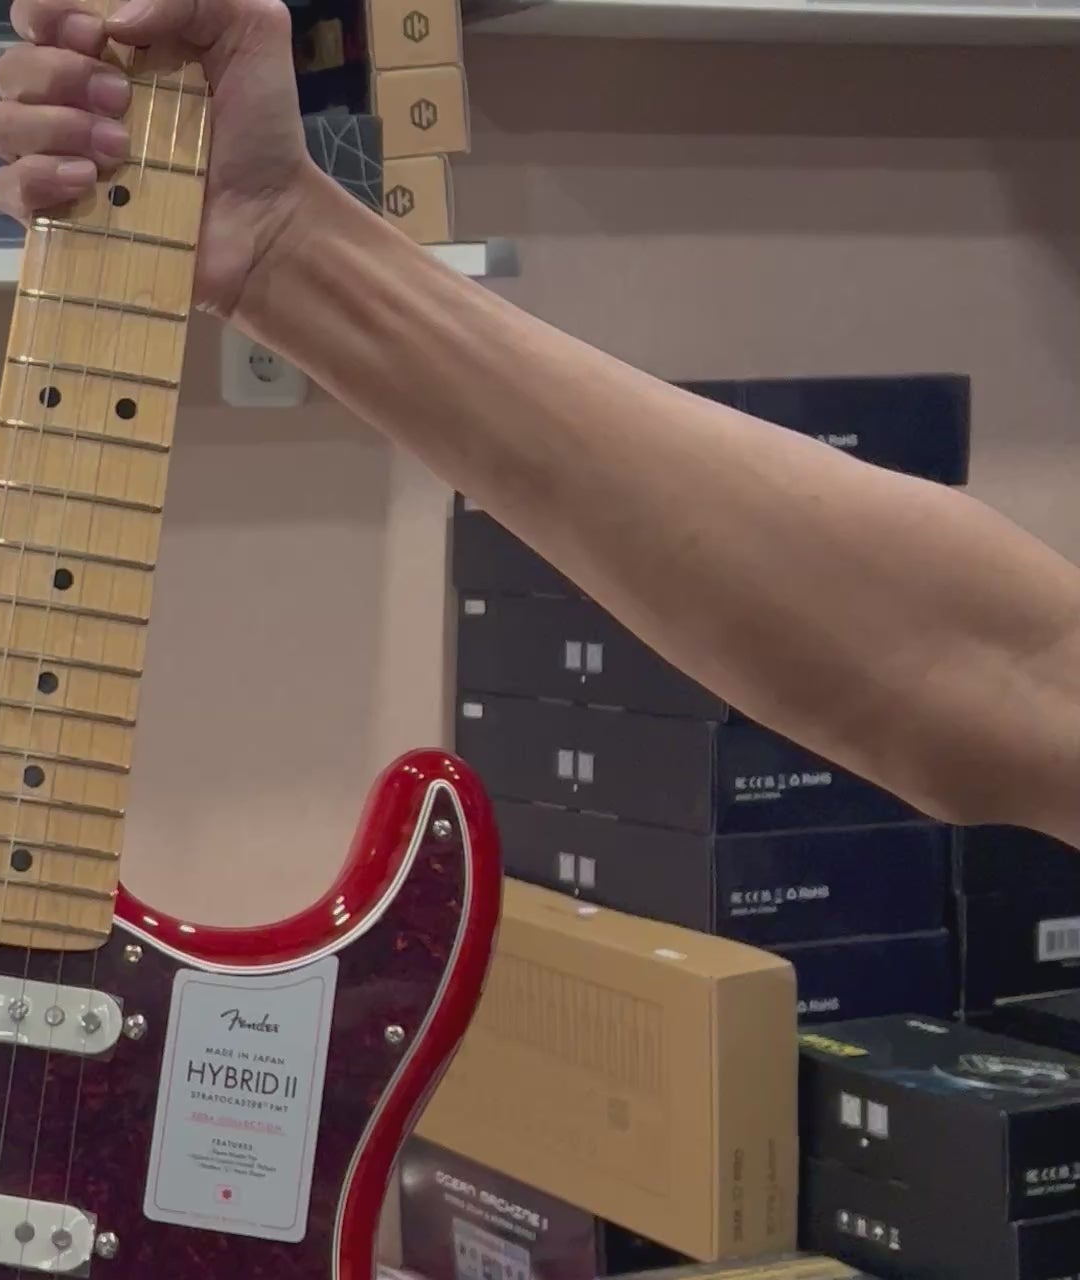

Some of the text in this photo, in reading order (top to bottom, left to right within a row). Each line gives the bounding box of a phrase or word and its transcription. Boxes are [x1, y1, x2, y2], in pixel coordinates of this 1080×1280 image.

[220, 1008, 280, 1034] Fender
[205, 1047, 233, 1058] MADE
[253, 1054, 285, 1065] JAPAN
[187, 1060, 297, 1099] HYBRID II
